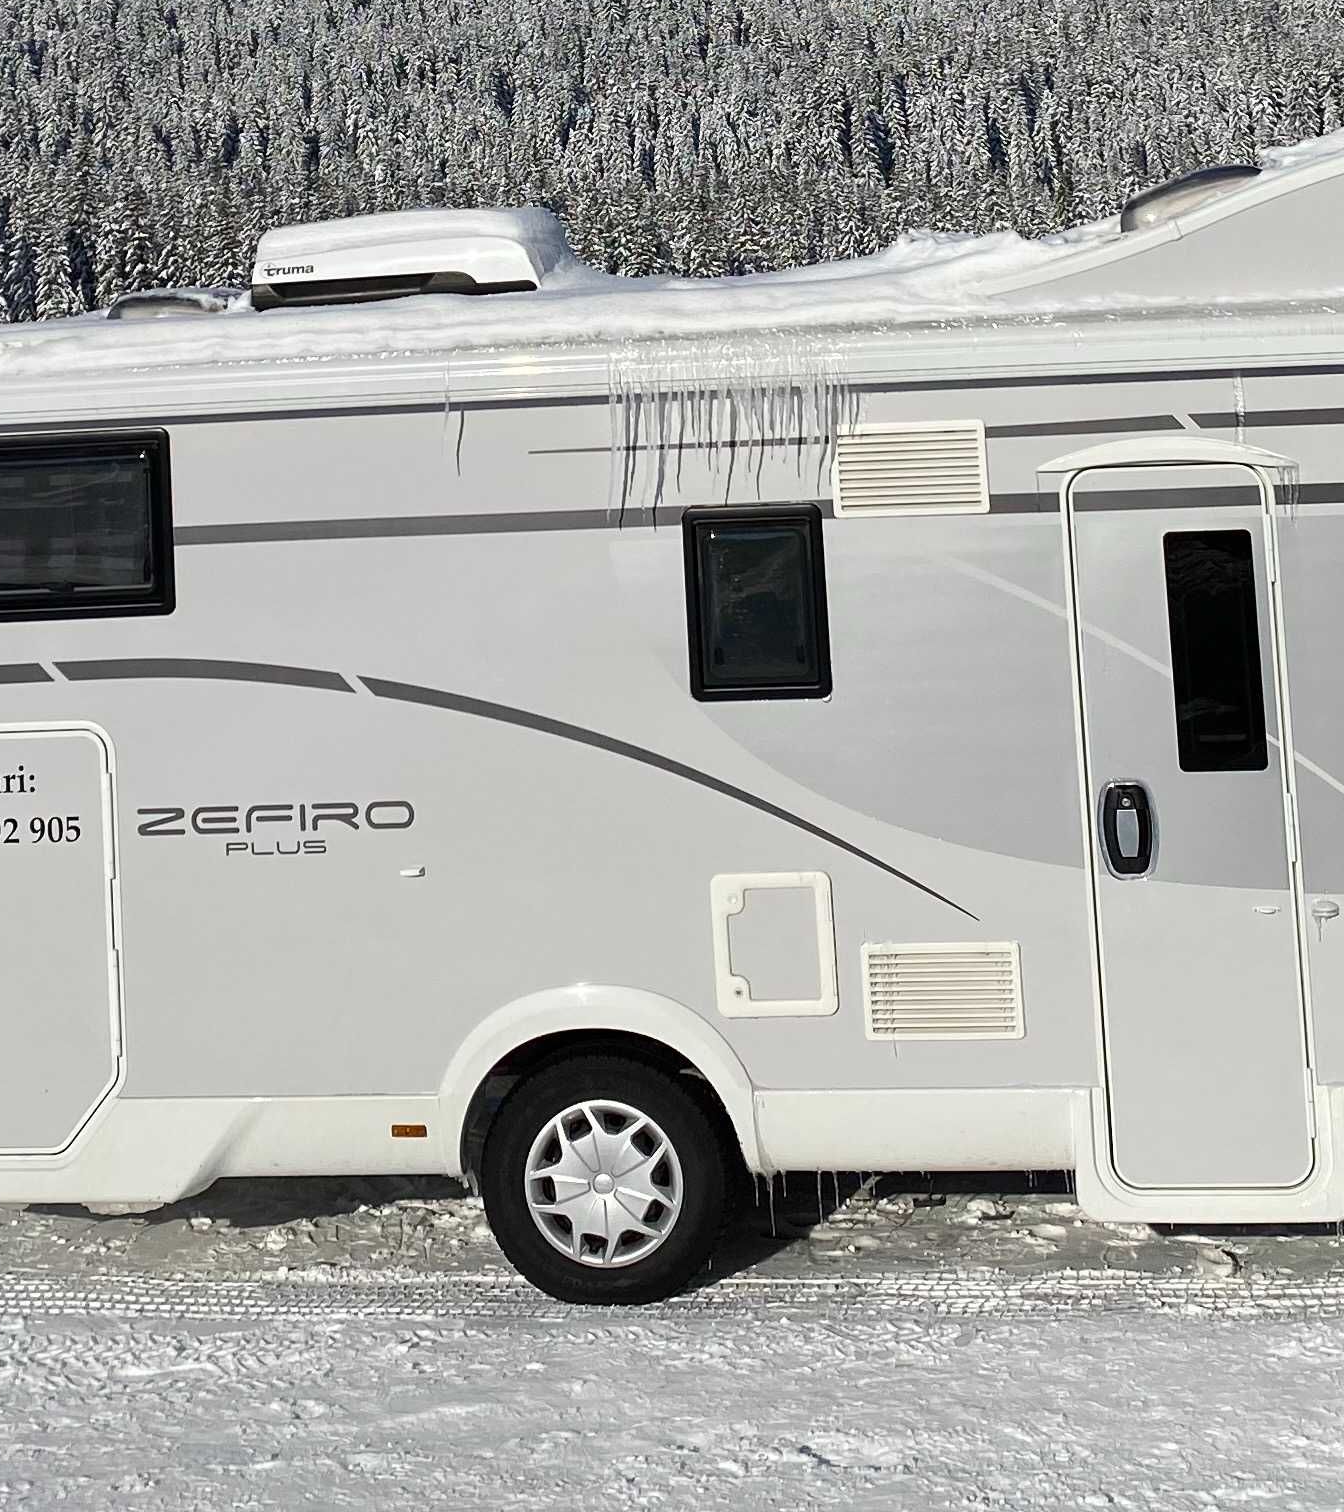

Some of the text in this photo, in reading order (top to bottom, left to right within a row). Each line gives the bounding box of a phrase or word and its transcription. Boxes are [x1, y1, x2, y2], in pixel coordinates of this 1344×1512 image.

[263, 264, 314, 277] truma
[137, 801, 415, 836] ZEFIRO
[29, 816, 81, 844] 905
[226, 840, 327, 856] PLUS
